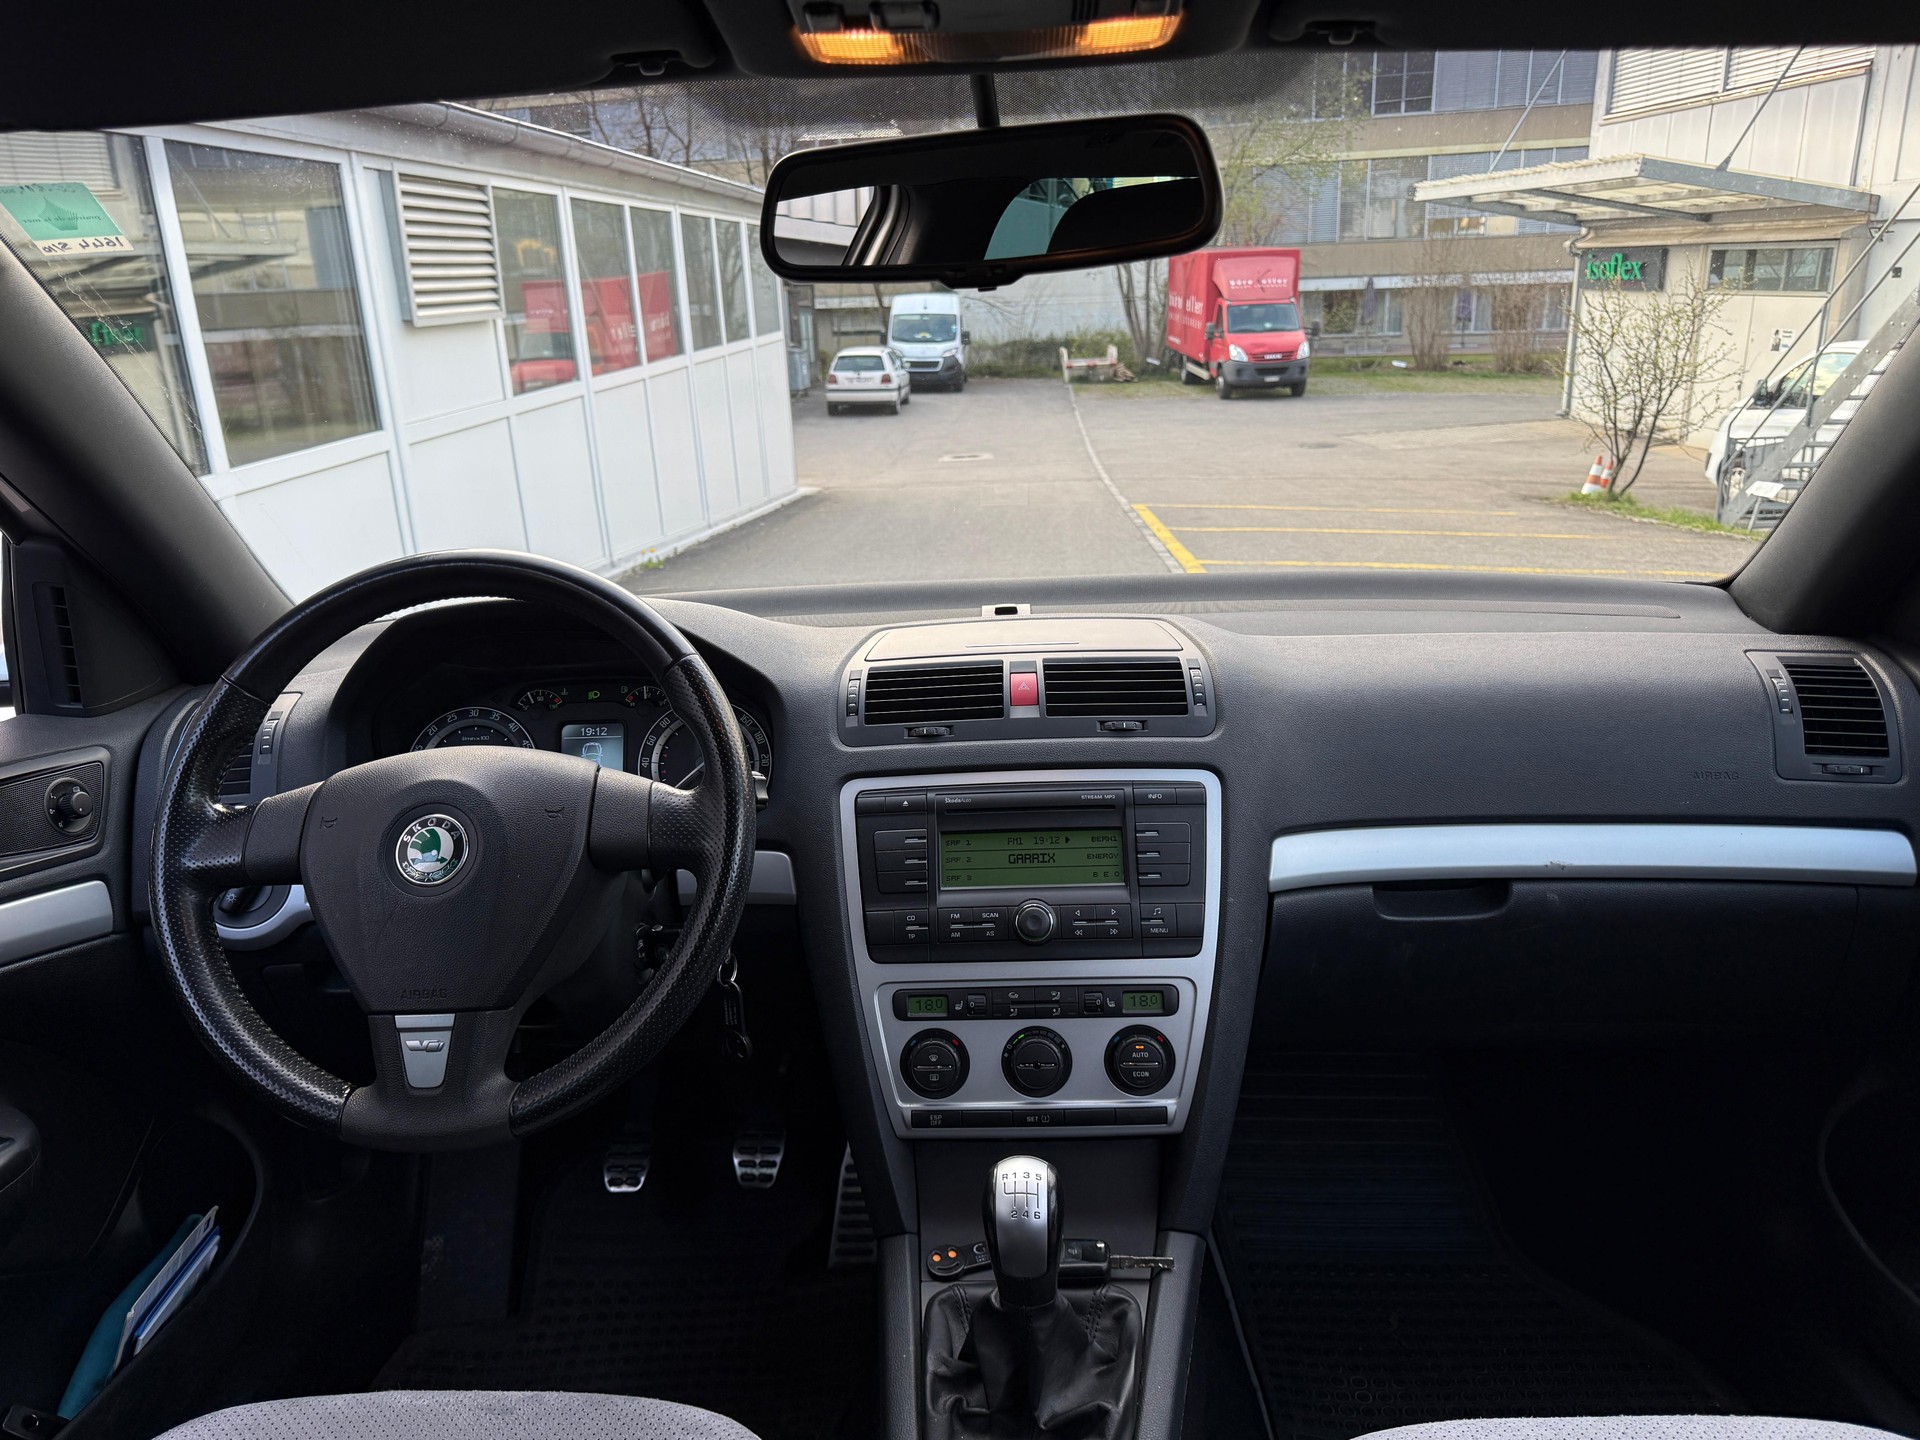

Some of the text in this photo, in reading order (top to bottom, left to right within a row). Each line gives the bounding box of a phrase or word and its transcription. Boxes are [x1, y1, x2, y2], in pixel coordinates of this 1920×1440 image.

[1585, 252, 1642, 281] isoflex
[446, 713, 458, 723] 25
[468, 709, 479, 718] 30
[489, 711, 502, 721] 35
[660, 717, 671, 728] 80
[740, 714, 753, 727] 160
[427, 725, 438, 736] 20
[508, 722, 519, 733] 40
[580, 727, 608, 736] 19:12
[646, 735, 657, 746] 60
[754, 731, 766, 745] 180
[641, 757, 650, 768] 40
[1694, 771, 1740, 781] AIRBAG
[403, 817, 461, 843] SKODA
[1007, 836, 1061, 846] FM1 19:12
[1008, 853, 1056, 865] GARRIX
[400, 988, 448, 999] AIRBAG
[1035, 1173, 1042, 1181] 5
[1011, 1210, 1041, 1220] 2 4 6
